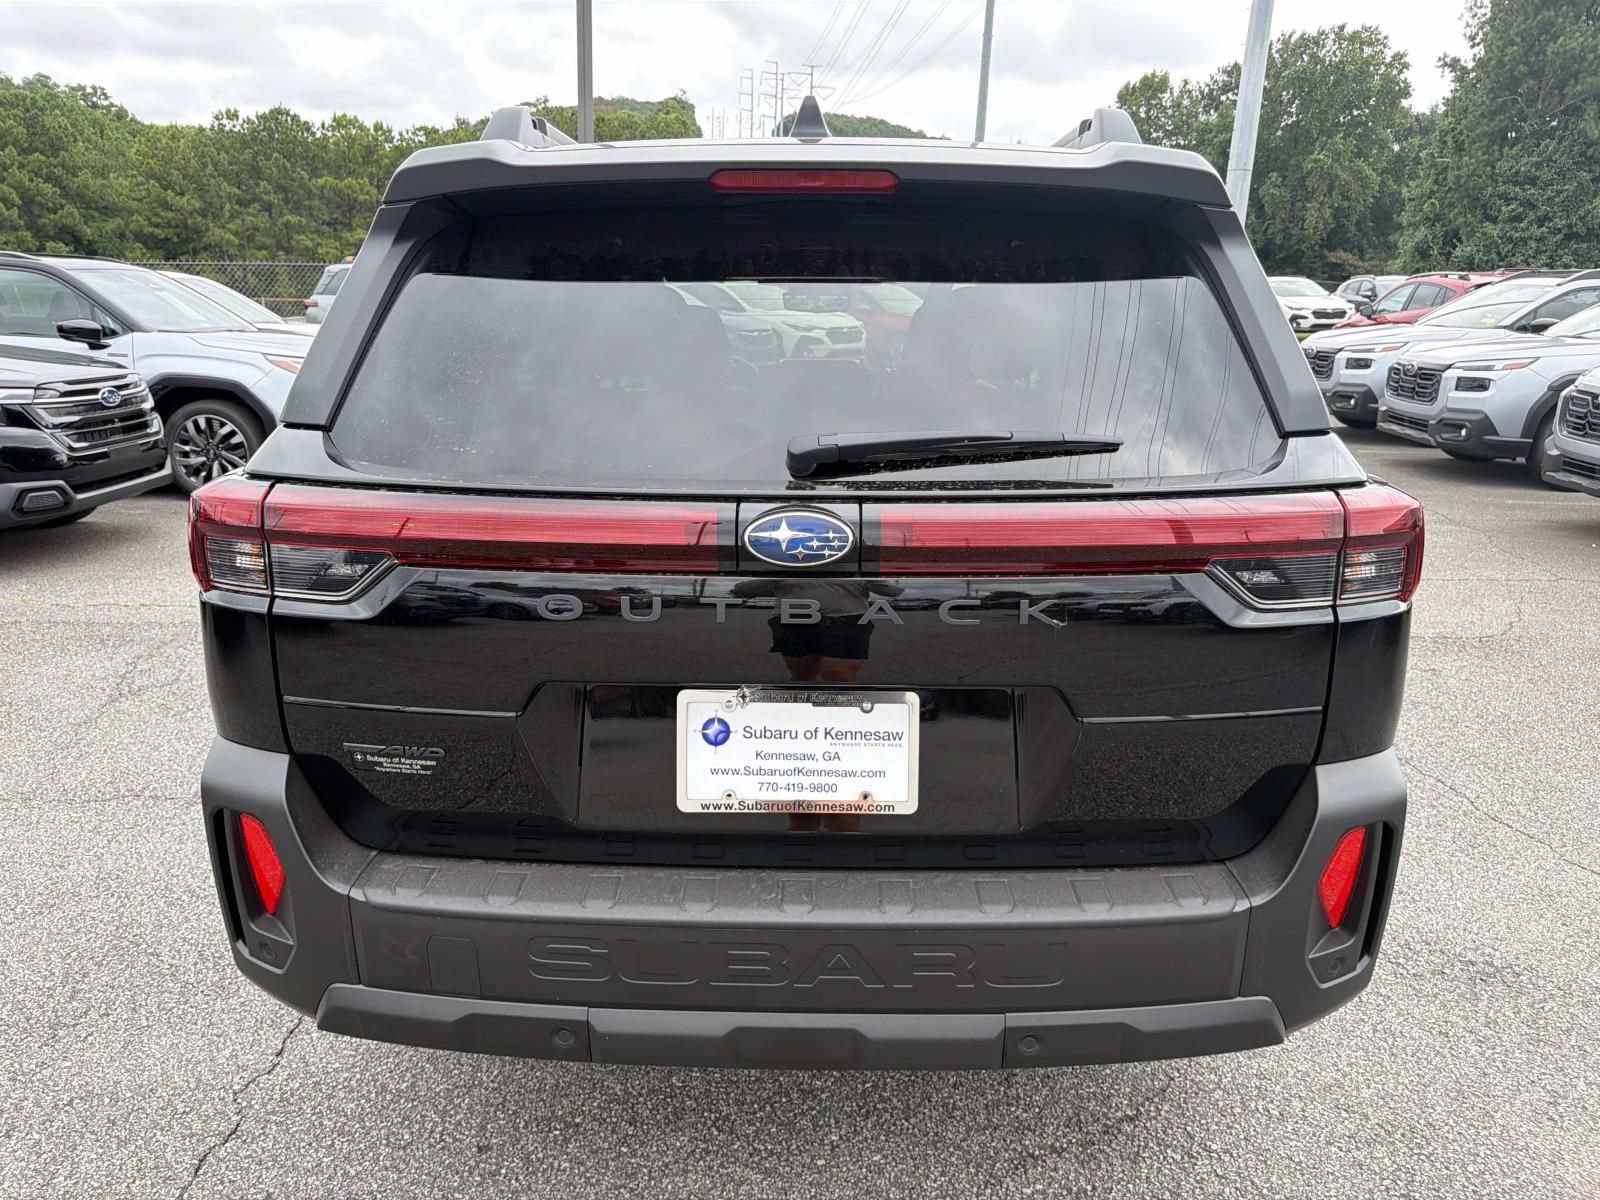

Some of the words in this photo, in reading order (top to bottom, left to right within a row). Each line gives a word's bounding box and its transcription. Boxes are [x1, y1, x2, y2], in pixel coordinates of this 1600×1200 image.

[536, 594, 1063, 625] OUTBACK
[742, 725, 799, 741] Subaru
[803, 726, 819, 741] of
[824, 727, 904, 742] Kennesaw
[381, 745, 445, 757] AWD
[755, 750, 819, 763] Kennesaw,
[822, 751, 841, 762] GA
[401, 757, 436, 765] Kennesaw
[710, 766, 886, 779] www.SubaruofKennesaw.com
[757, 781, 838, 793] 770-419-9800
[701, 800, 895, 813] www.SubaruofKennesaw.com
[527, 935, 1068, 988] SUBARU
